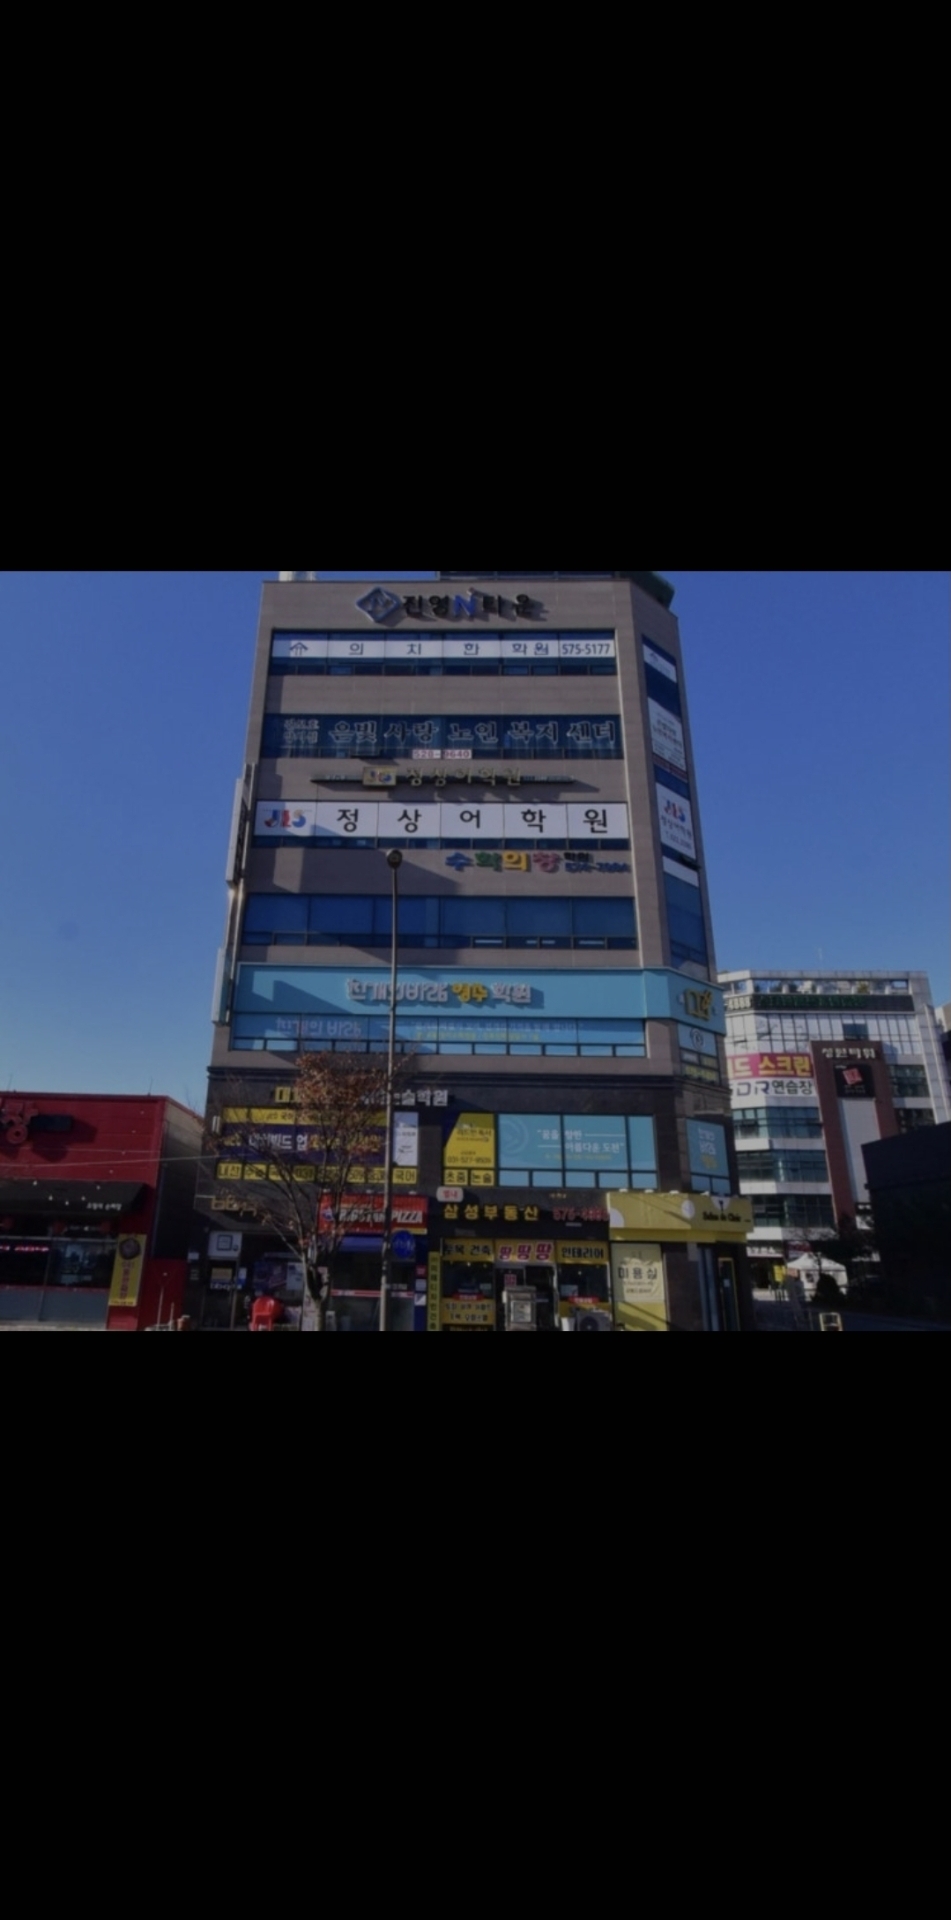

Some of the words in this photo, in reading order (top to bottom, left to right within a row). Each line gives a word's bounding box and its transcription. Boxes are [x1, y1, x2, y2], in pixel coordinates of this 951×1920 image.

[561, 642, 611, 656] 575-5177
[327, 720, 378, 744] 은빛
[383, 720, 439, 744] 사랑
[447, 720, 498, 744] 노인
[507, 720, 559, 744] 복지
[565, 720, 616, 744] 센터
[336, 808, 609, 834] 정상어학원
[758, 1055, 811, 1076] 스크린
[391, 1208, 423, 1223] PIZZA
[443, 1203, 540, 1222] 삼성부동산
[561, 1245, 605, 1259] 인테리어
